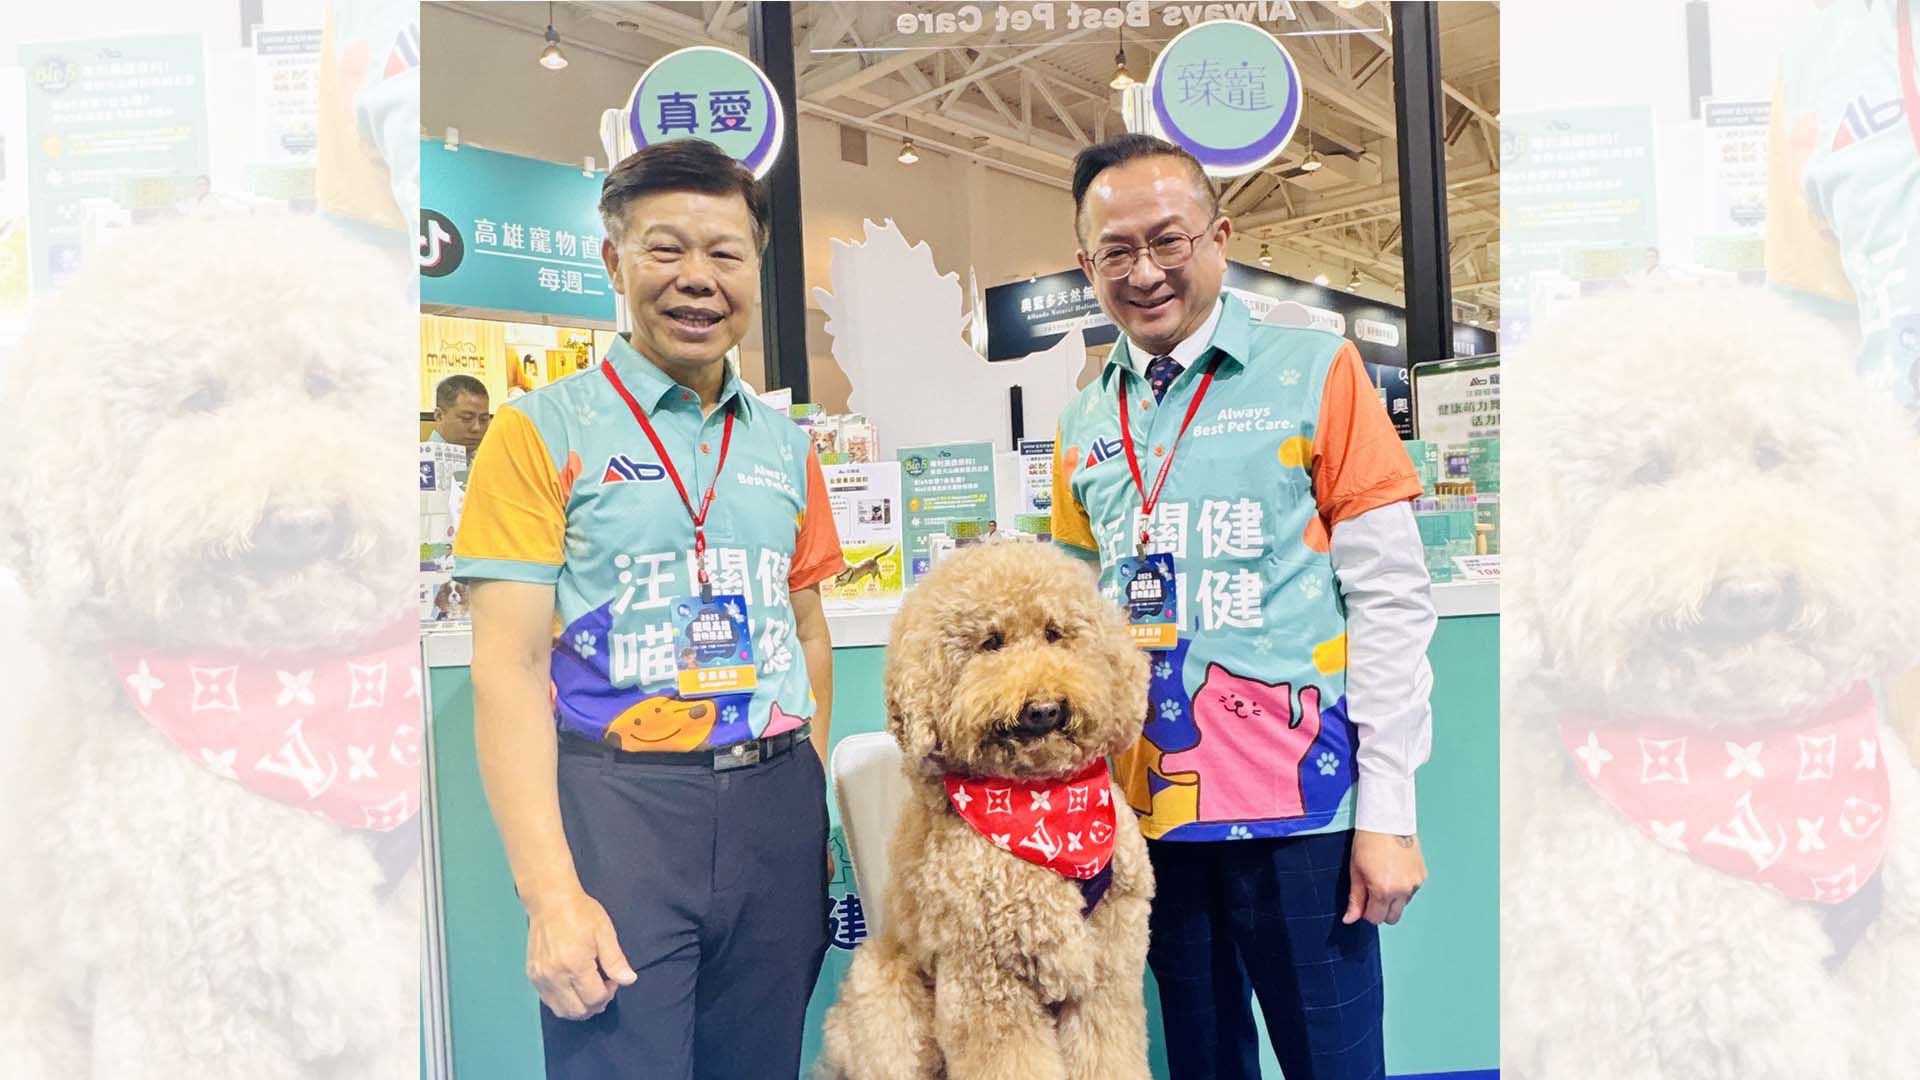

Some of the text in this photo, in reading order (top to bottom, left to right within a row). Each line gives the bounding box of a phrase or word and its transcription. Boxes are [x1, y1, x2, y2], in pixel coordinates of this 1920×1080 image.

[656, 90, 753, 135] 真愛
[1217, 407, 1271, 421] Always
[1193, 418, 1295, 437] Best Pet Care.
